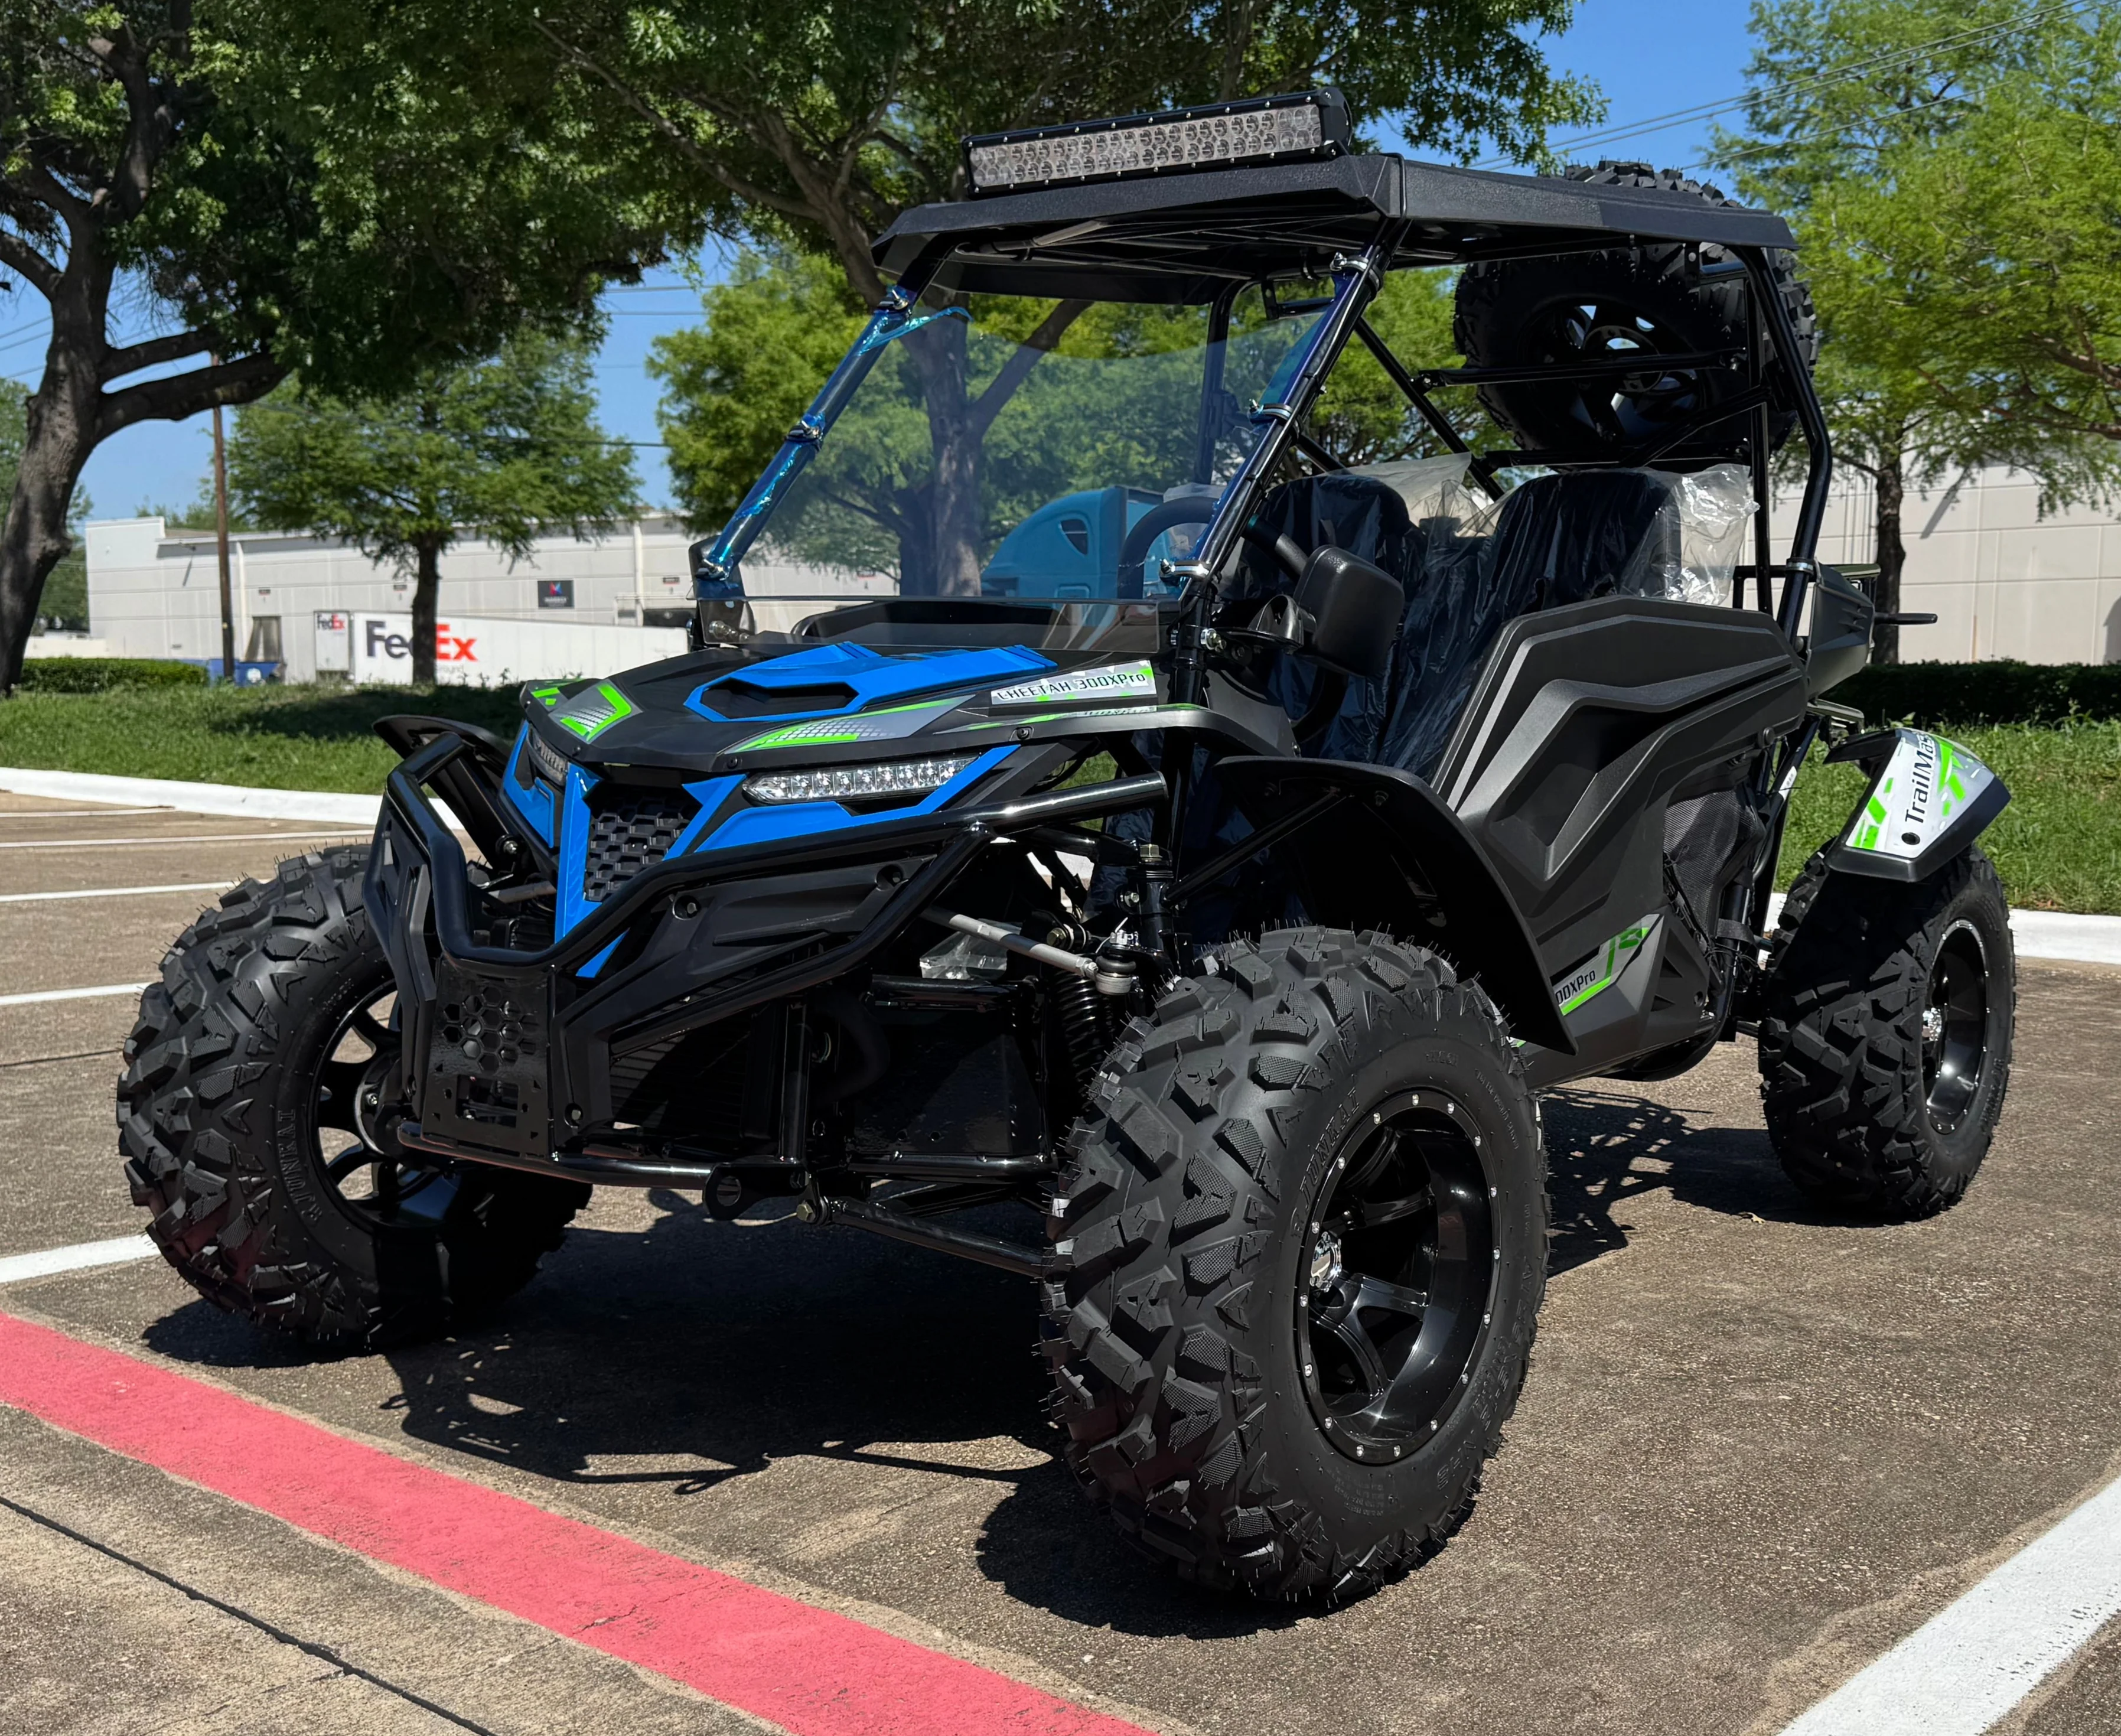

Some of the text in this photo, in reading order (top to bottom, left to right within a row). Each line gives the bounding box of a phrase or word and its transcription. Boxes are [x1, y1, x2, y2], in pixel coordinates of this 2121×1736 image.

[315, 613, 345, 630] FedEx
[366, 621, 477, 661] FeEx
[997, 681, 1071, 701] CHEETAH
[1074, 673, 1145, 689] 300XPro
[1905, 732, 1936, 823] TrailMas
[278, 1109, 315, 1204] JUNKAI
[1300, 1088, 1361, 1214] JUNKAI
